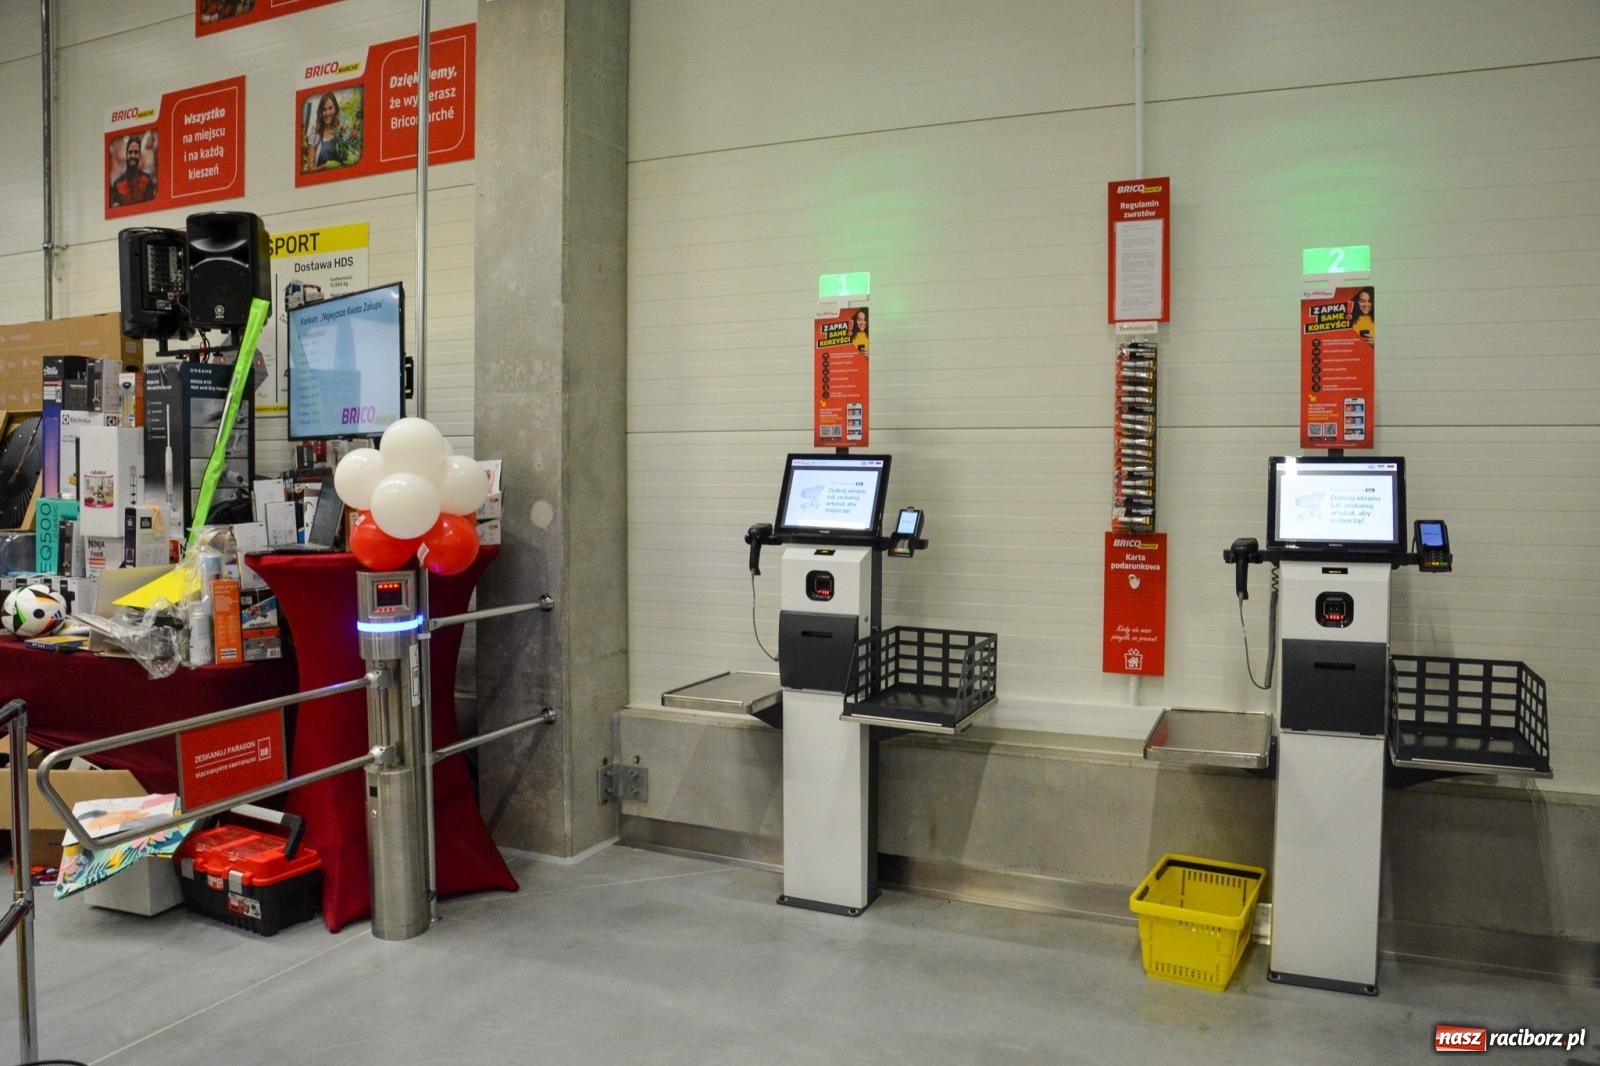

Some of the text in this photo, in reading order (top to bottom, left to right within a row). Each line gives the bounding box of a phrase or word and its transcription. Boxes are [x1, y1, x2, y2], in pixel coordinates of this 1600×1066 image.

[304, 61, 339, 79] BRICO
[390, 97, 400, 110] że
[112, 107, 138, 122] BRICO
[184, 107, 226, 125] Wszystko
[183, 127, 226, 144] na miejscu
[184, 146, 224, 162] i na każdą
[188, 164, 218, 180] kieszeń
[1117, 184, 1144, 194] BRICO
[1120, 200, 1160, 210] Regulamin
[1124, 210, 1156, 218] zwrotów
[294, 257, 354, 272] Dostawa HDS
[1328, 248, 1345, 274] 2
[838, 273, 849, 296] 1
[1321, 313, 1344, 321] SAME
[1308, 321, 1350, 331] KORZYŚCI
[342, 406, 376, 425] BRICO
[40, 502, 52, 574] EQ500
[1113, 539, 1142, 547] BRICO
[1110, 562, 1160, 571] podarunkowa
[194, 741, 256, 764] ZESKANUJ PARAGON
